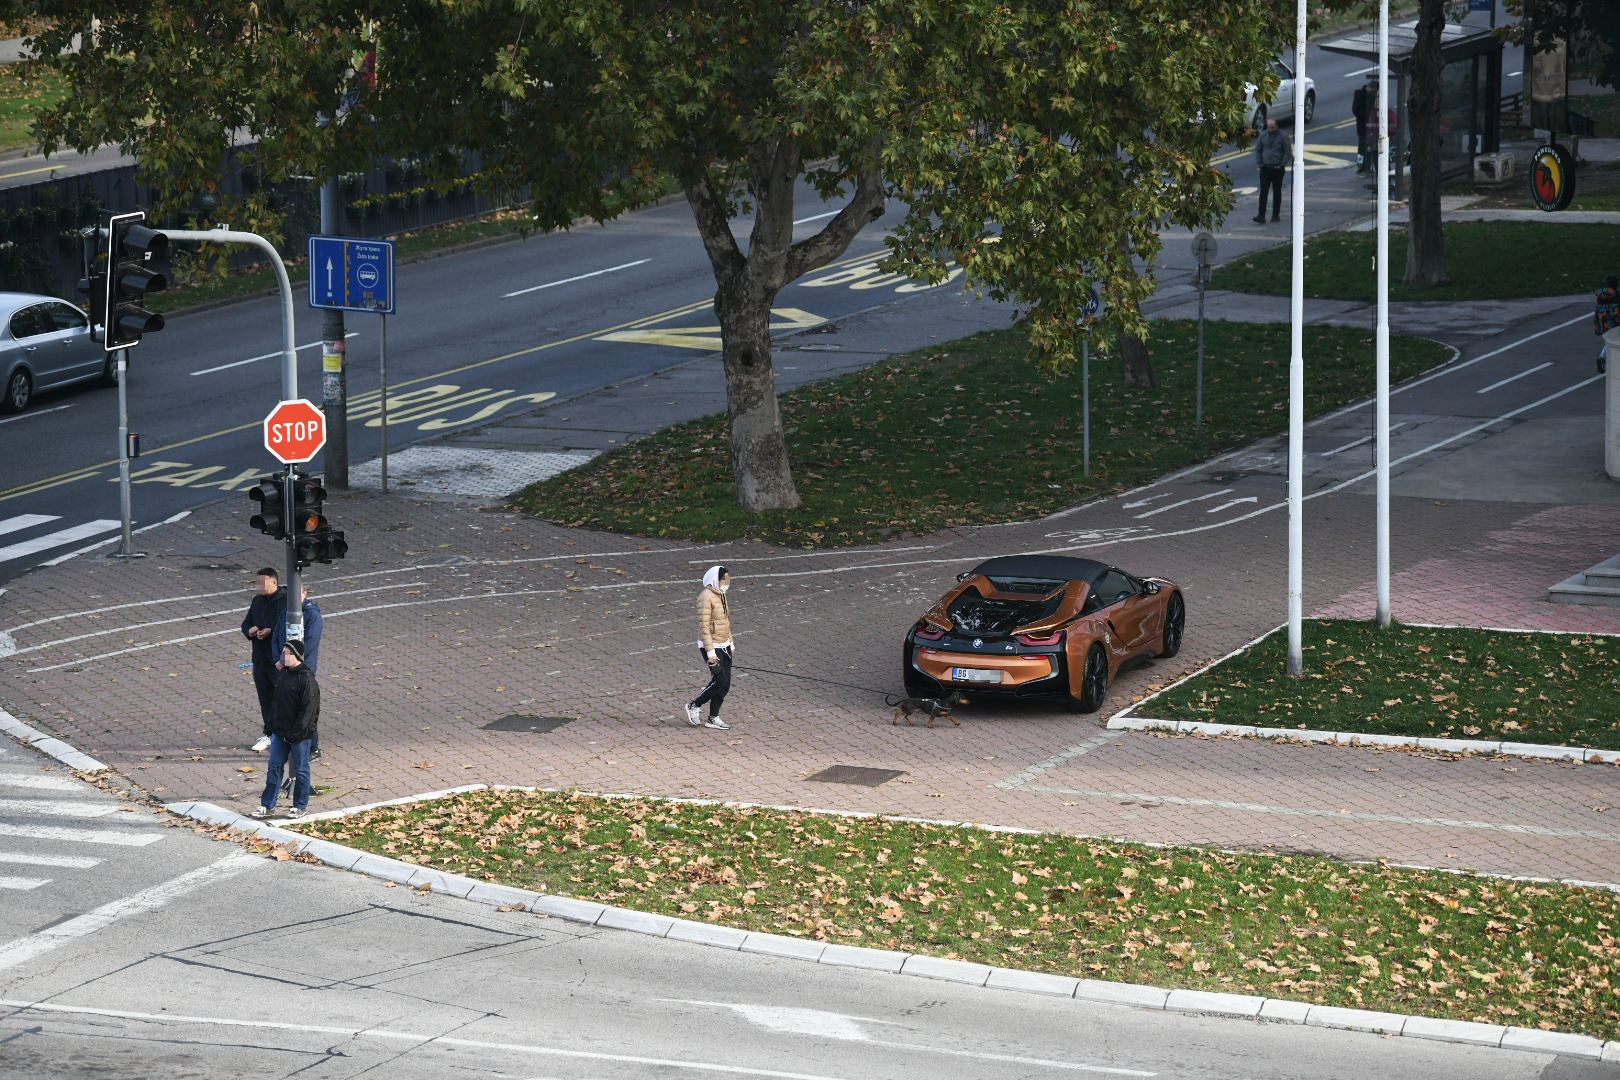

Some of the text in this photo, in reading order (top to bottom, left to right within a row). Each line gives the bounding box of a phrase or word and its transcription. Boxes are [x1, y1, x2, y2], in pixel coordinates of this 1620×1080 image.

[346, 384, 557, 431] BUS
[272, 420, 318, 444] STOP
[958, 670, 967, 678] BG
